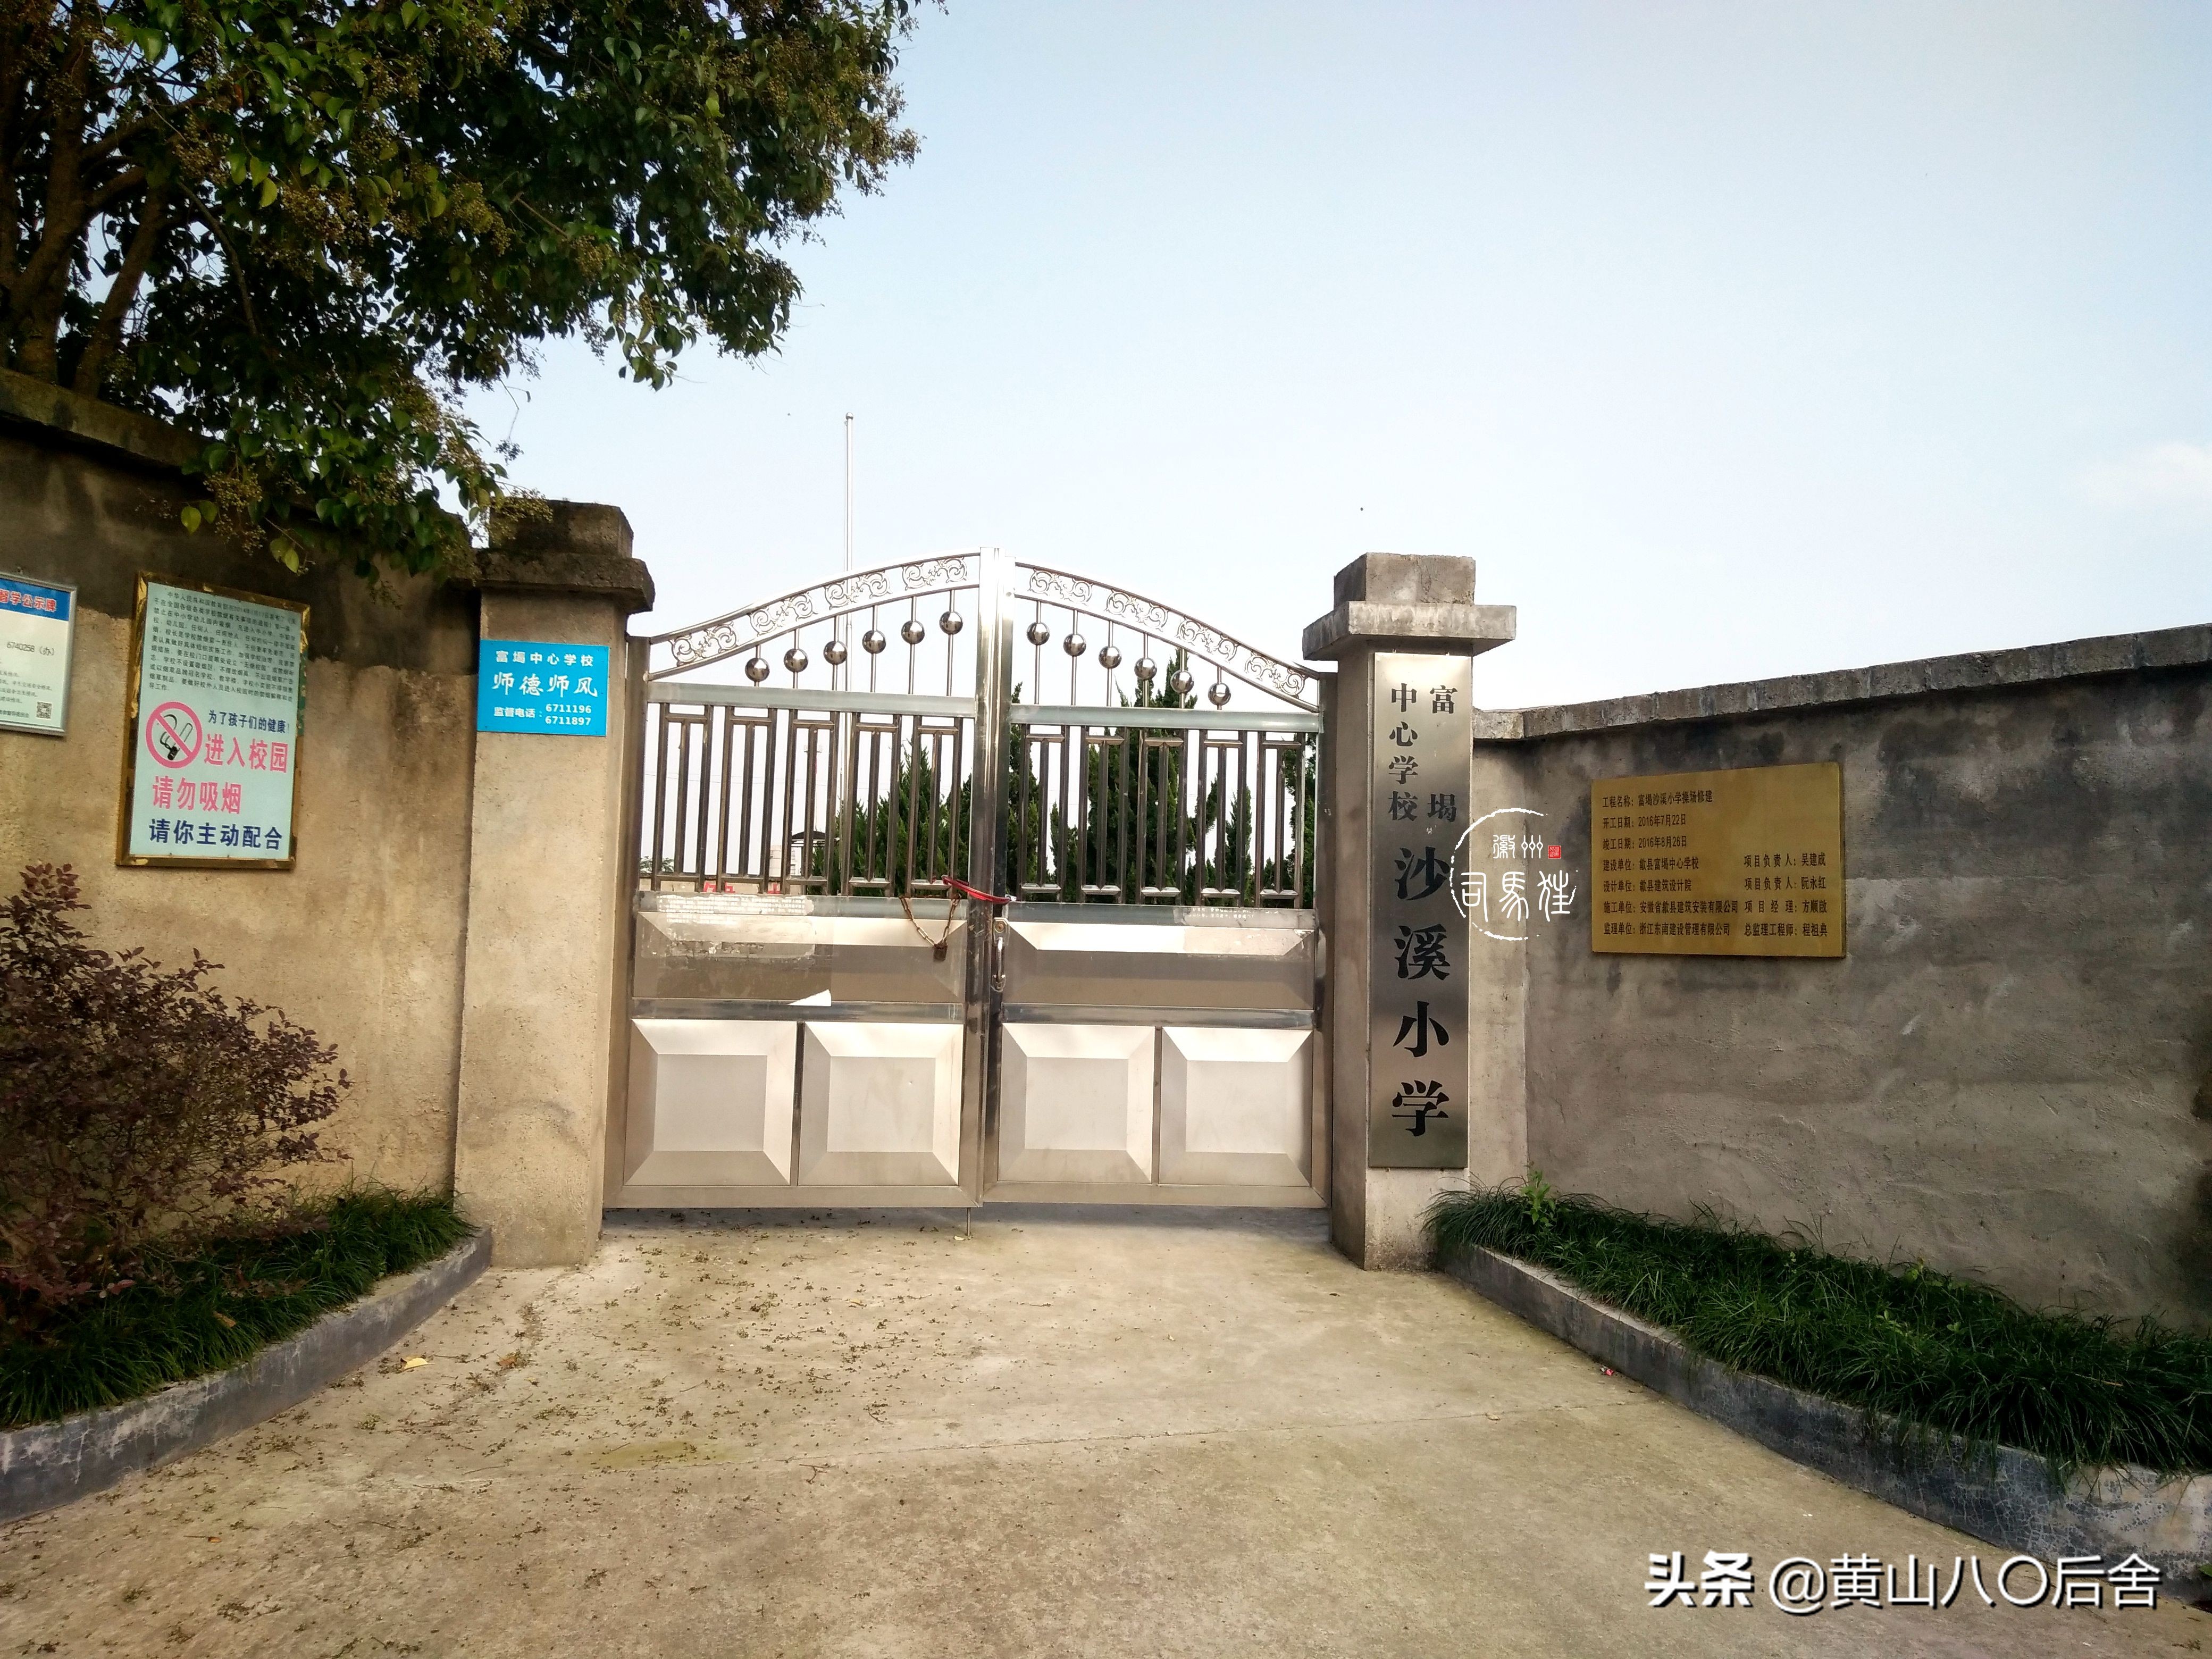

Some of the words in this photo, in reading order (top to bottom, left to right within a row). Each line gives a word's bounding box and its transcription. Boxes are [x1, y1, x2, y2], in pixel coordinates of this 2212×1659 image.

[492, 672, 598, 698] 师德师风
[545, 716, 591, 726] 6711897
[546, 703, 592, 714] 6711196
[204, 733, 288, 773] 进入校园
[1388, 683, 1418, 822] 中心学校
[153, 775, 242, 814] 请勿吸烟
[149, 818, 282, 850] 请你主动配合
[1392, 847, 1450, 1137] 沙溪小学
